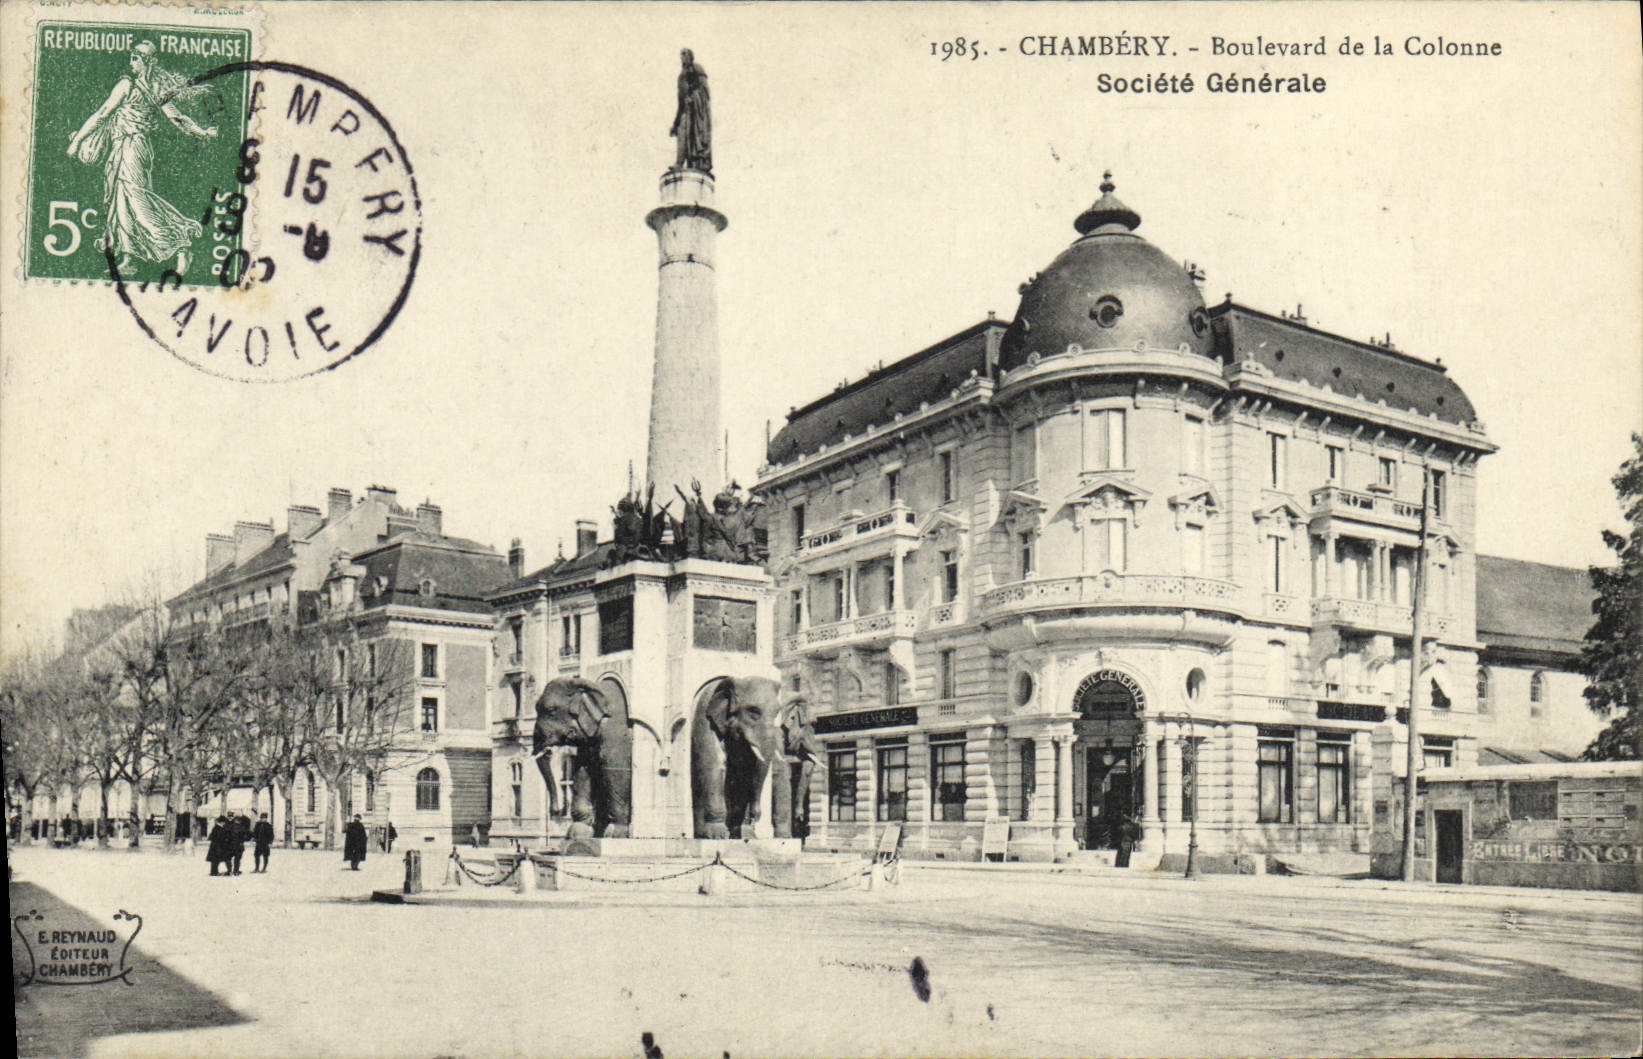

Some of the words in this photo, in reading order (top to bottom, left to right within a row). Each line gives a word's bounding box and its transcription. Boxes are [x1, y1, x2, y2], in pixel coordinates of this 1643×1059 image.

[160, 34, 242, 58] FRANÇAISE
[284, 154, 331, 204] 15
[212, 192, 232, 276] POSTES
